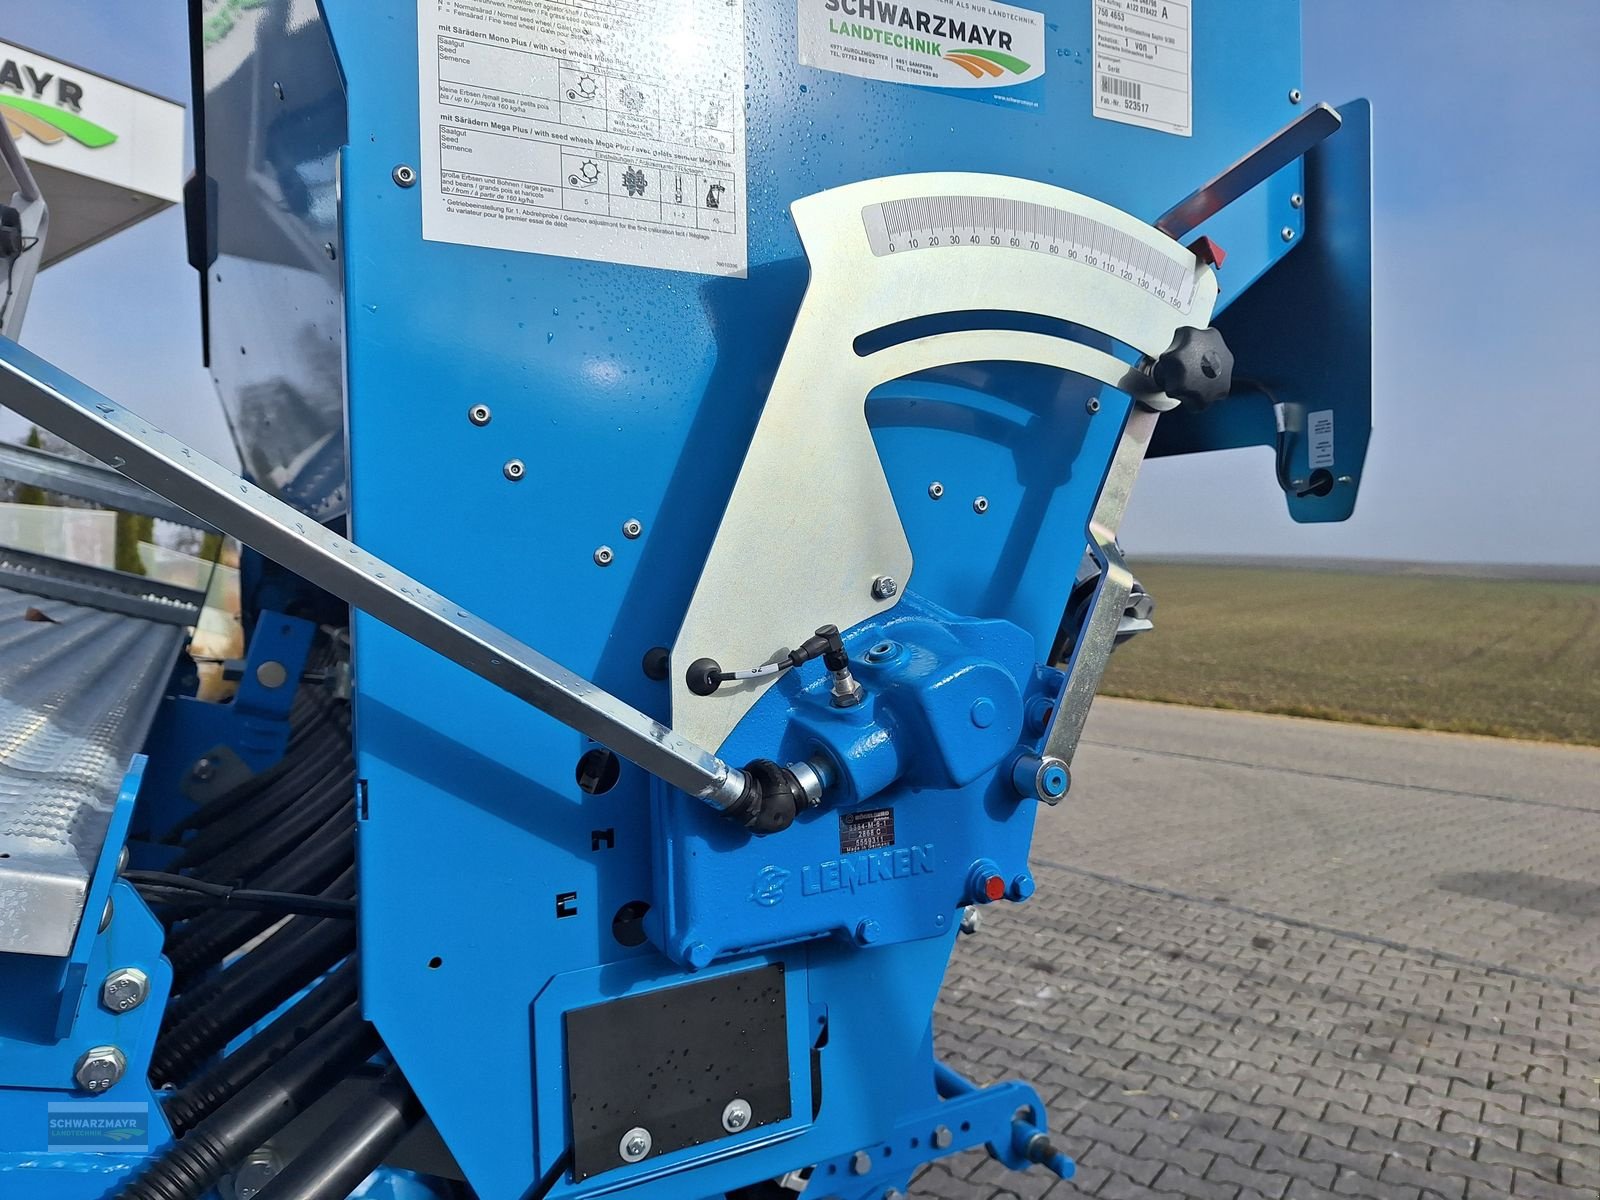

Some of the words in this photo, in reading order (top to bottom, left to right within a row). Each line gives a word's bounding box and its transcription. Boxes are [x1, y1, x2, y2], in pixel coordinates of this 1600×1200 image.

[498, 10, 518, 20] Normal
[956, 1, 969, 9] ALS
[972, 4, 986, 13] NUR
[989, 9, 1036, 25] LANDTECHNIK.
[1098, 7, 1108, 17] 750
[1126, 3, 1138, 12] A122
[1162, 6, 1168, 19] A
[489, 16, 501, 24] Fine
[438, 24, 451, 32] mit
[489, 34, 509, 43] Mono
[512, 38, 527, 47] Plus
[533, 42, 548, 51] with
[550, 45, 566, 54] seed
[569, 49, 592, 60] wheels
[440, 38, 464, 48] Saatgut
[830, 18, 942, 57] LANDTECHNIK
[440, 45, 456, 54] Seed
[1125, 38, 1128, 47] 1
[1135, 42, 1147, 51] von
[1155, 46, 1158, 54] 1
[440, 53, 470, 64] Semence
[460, 89, 480, 97] Erbsen
[521, 99, 535, 108] petits
[1125, 99, 1149, 113] 523517
[441, 126, 466, 136] Saatgut
[491, 121, 510, 131] Mega
[513, 125, 528, 133] Plus
[535, 129, 549, 138] with
[552, 132, 568, 140] seed
[570, 134, 594, 144] wheels
[441, 135, 458, 143] Seed
[441, 143, 472, 153] Semence
[456, 180, 474, 188] beans
[479, 183, 499, 192] grands
[521, 189, 544, 198] haricots
[497, 179, 519, 188] Bohnen
[447, 199, 504, 213] Getriebeeinstellung
[522, 210, 559, 220] Abdrehprobe
[564, 215, 587, 224] Gearbox
[456, 208, 482, 216] variateur
[505, 214, 527, 222] premier
[889, 243, 895, 252] 0
[908, 238, 919, 249] 10
[928, 236, 940, 246] 20
[949, 235, 960, 245] 30
[969, 235, 980, 244] 40
[990, 236, 1000, 245] 50
[1009, 237, 1021, 247] 60
[1029, 240, 1040, 250] 70
[1049, 244, 1060, 254] 80
[1067, 249, 1078, 259] 90
[1084, 254, 1098, 266] 100
[1102, 261, 1115, 273] 110
[1120, 268, 1133, 281] 120
[1136, 276, 1150, 290] 130
[1153, 286, 1166, 299] 140
[1169, 296, 1181, 309] 150
[802, 844, 934, 896] LEMKEN
